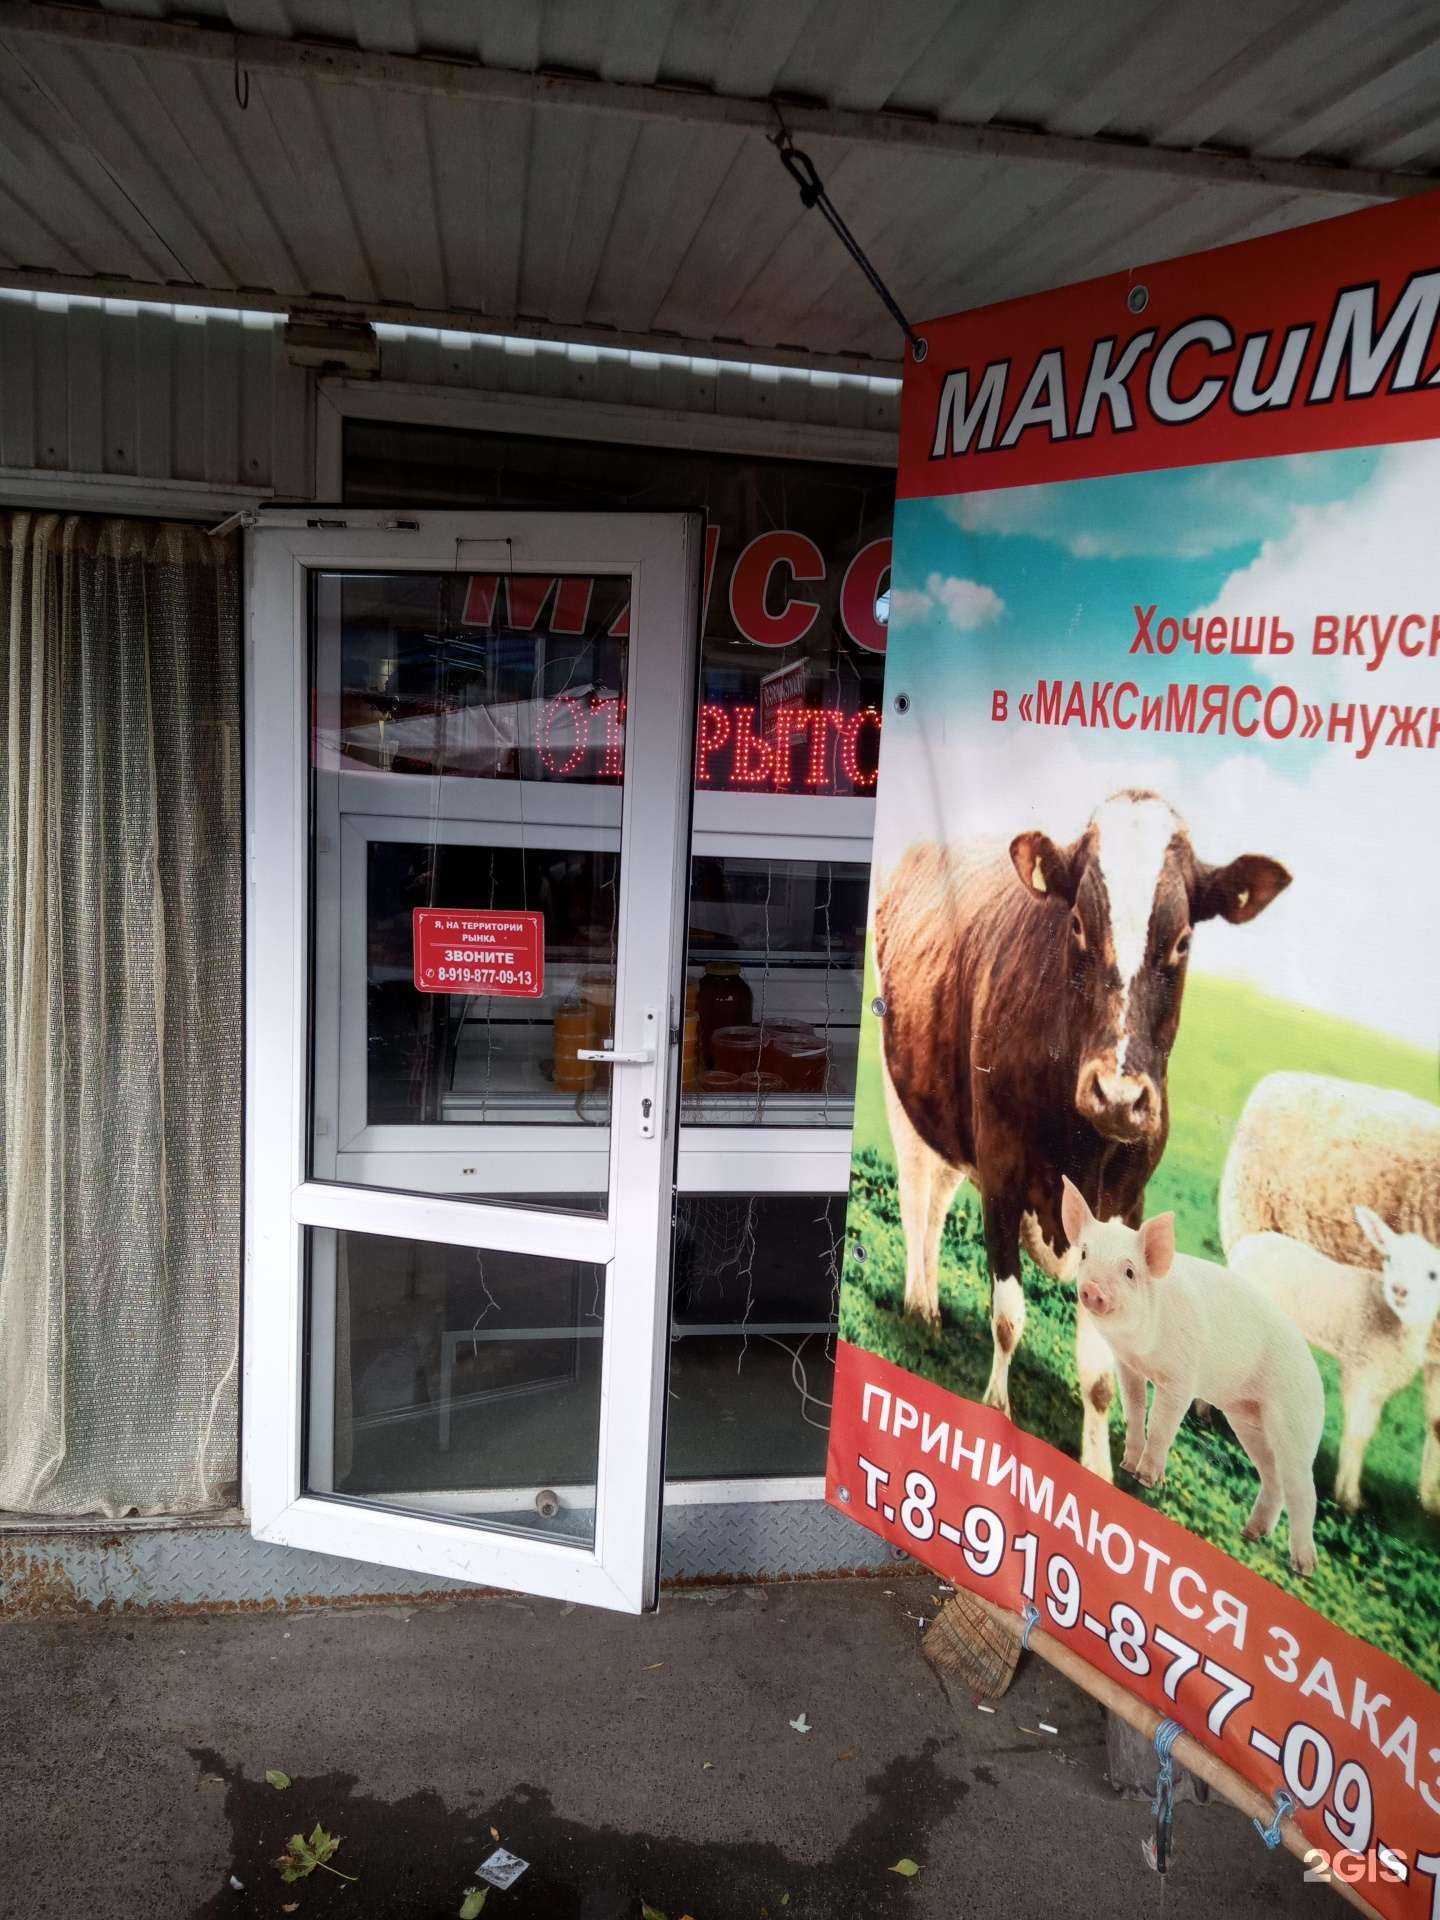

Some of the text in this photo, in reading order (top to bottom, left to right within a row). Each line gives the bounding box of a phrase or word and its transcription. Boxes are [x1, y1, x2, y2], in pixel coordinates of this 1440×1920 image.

[928, 267, 1440, 461] МАКСиМ
[1129, 604, 1296, 656] Хочешь
[991, 689, 1009, 722] в
[434, 920, 523, 932] Я, НА ТЕРРИТОРИИ
[462, 934, 496, 943] РЫНКА
[444, 950, 515, 964] ЗВОНИТЕ
[438, 967, 532, 985] 8-919-877-09-13
[861, 1382, 1250, 1651] ПРИНИМАЮТСЯ
